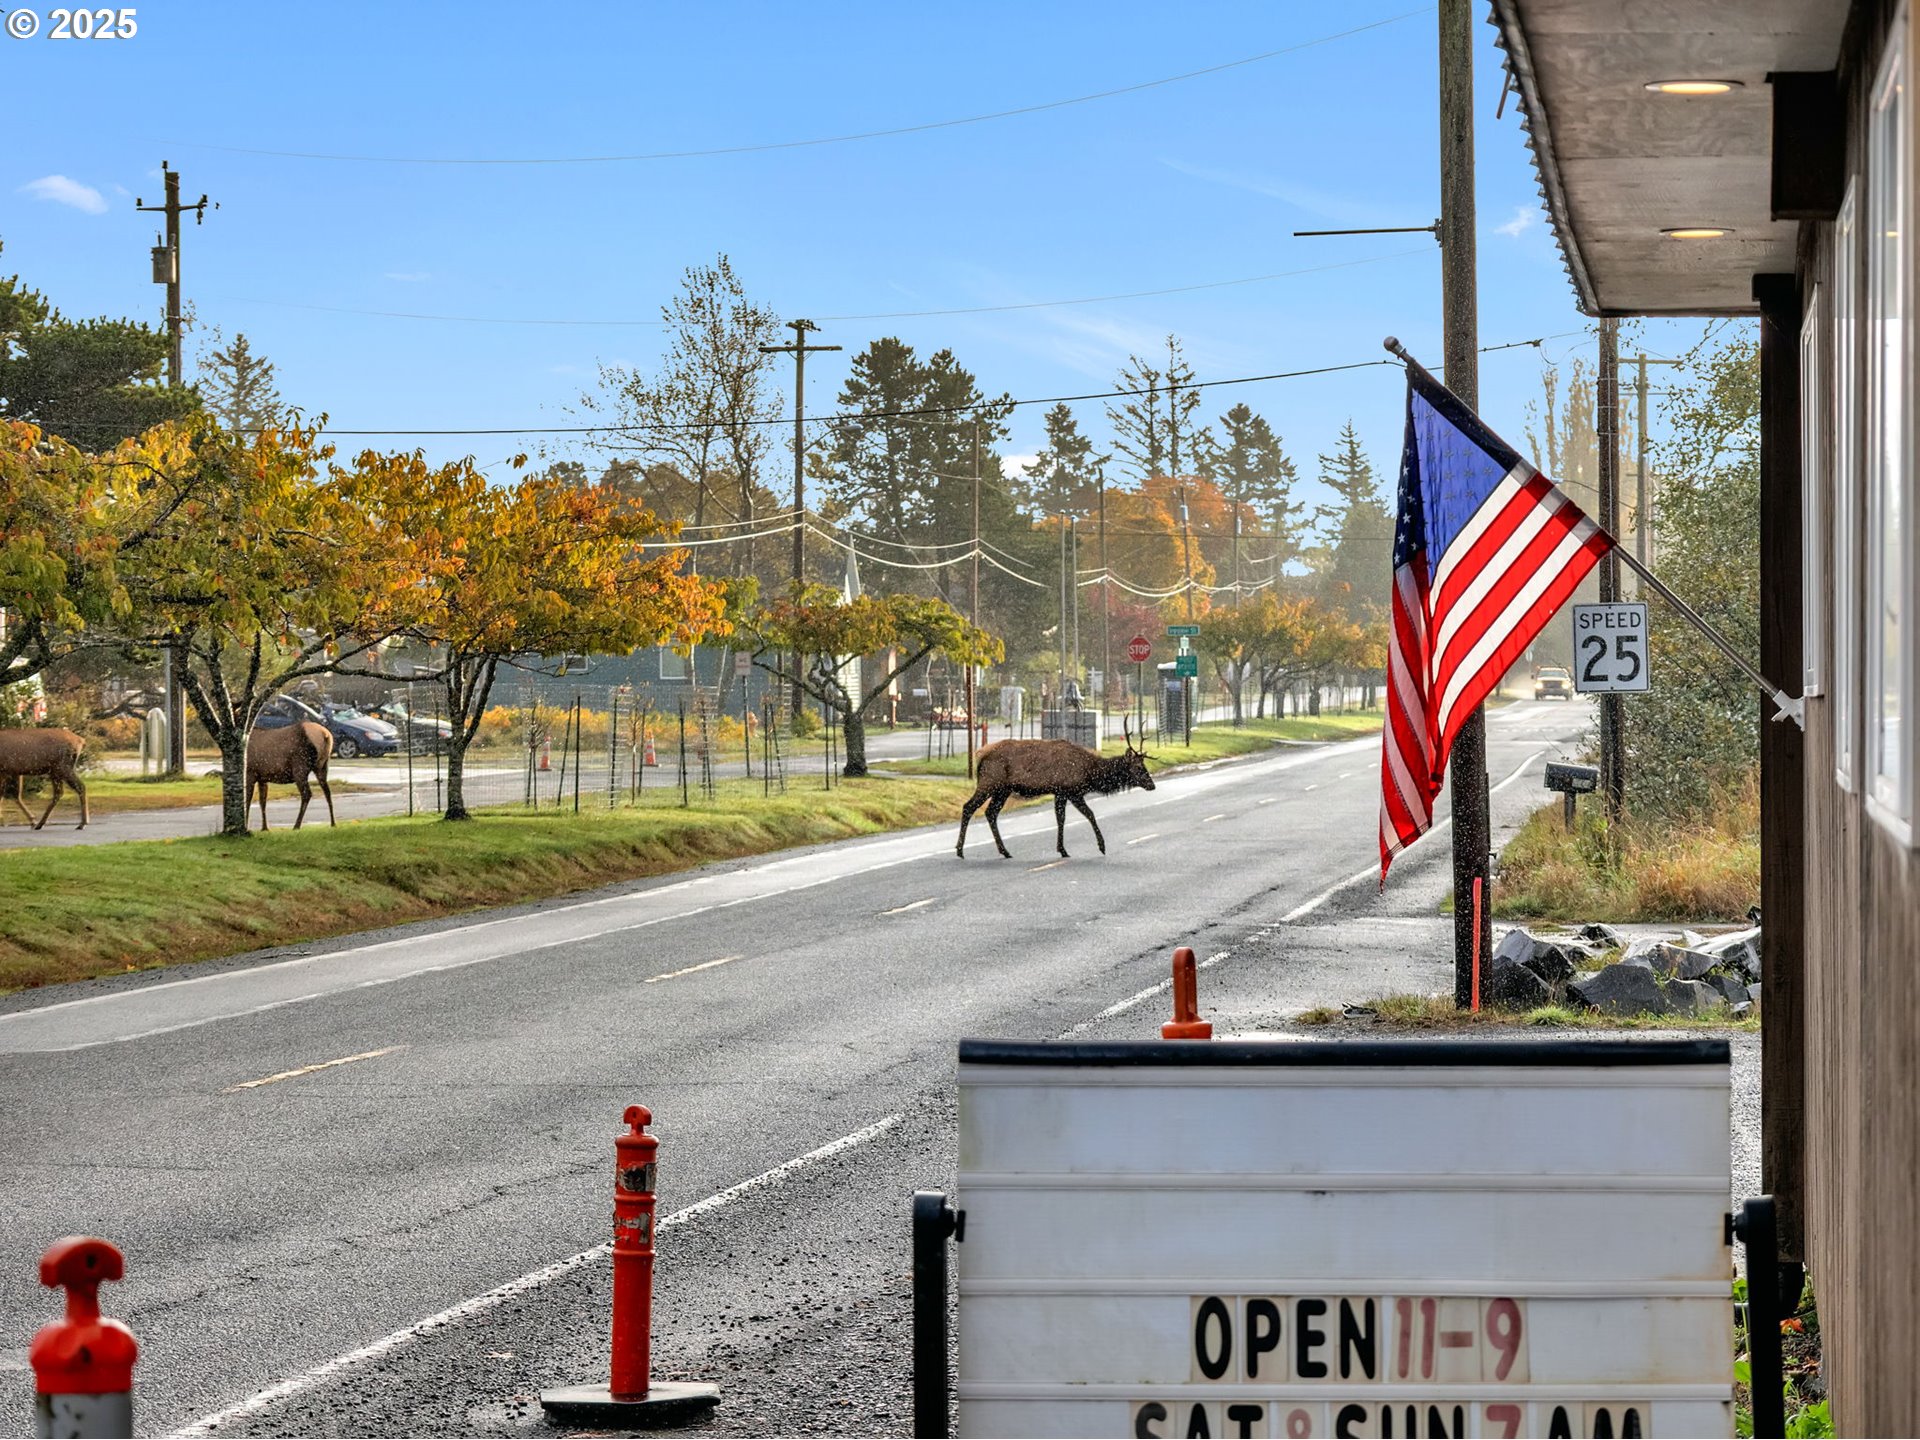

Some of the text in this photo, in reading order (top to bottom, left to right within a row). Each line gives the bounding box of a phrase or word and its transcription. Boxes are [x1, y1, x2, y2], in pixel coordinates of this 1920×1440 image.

[1579, 612, 1641, 629] SPEED
[1129, 644, 1150, 655] STOP
[1581, 635, 1640, 682] 25
[1195, 1296, 1522, 1381] OPEN 11-9
